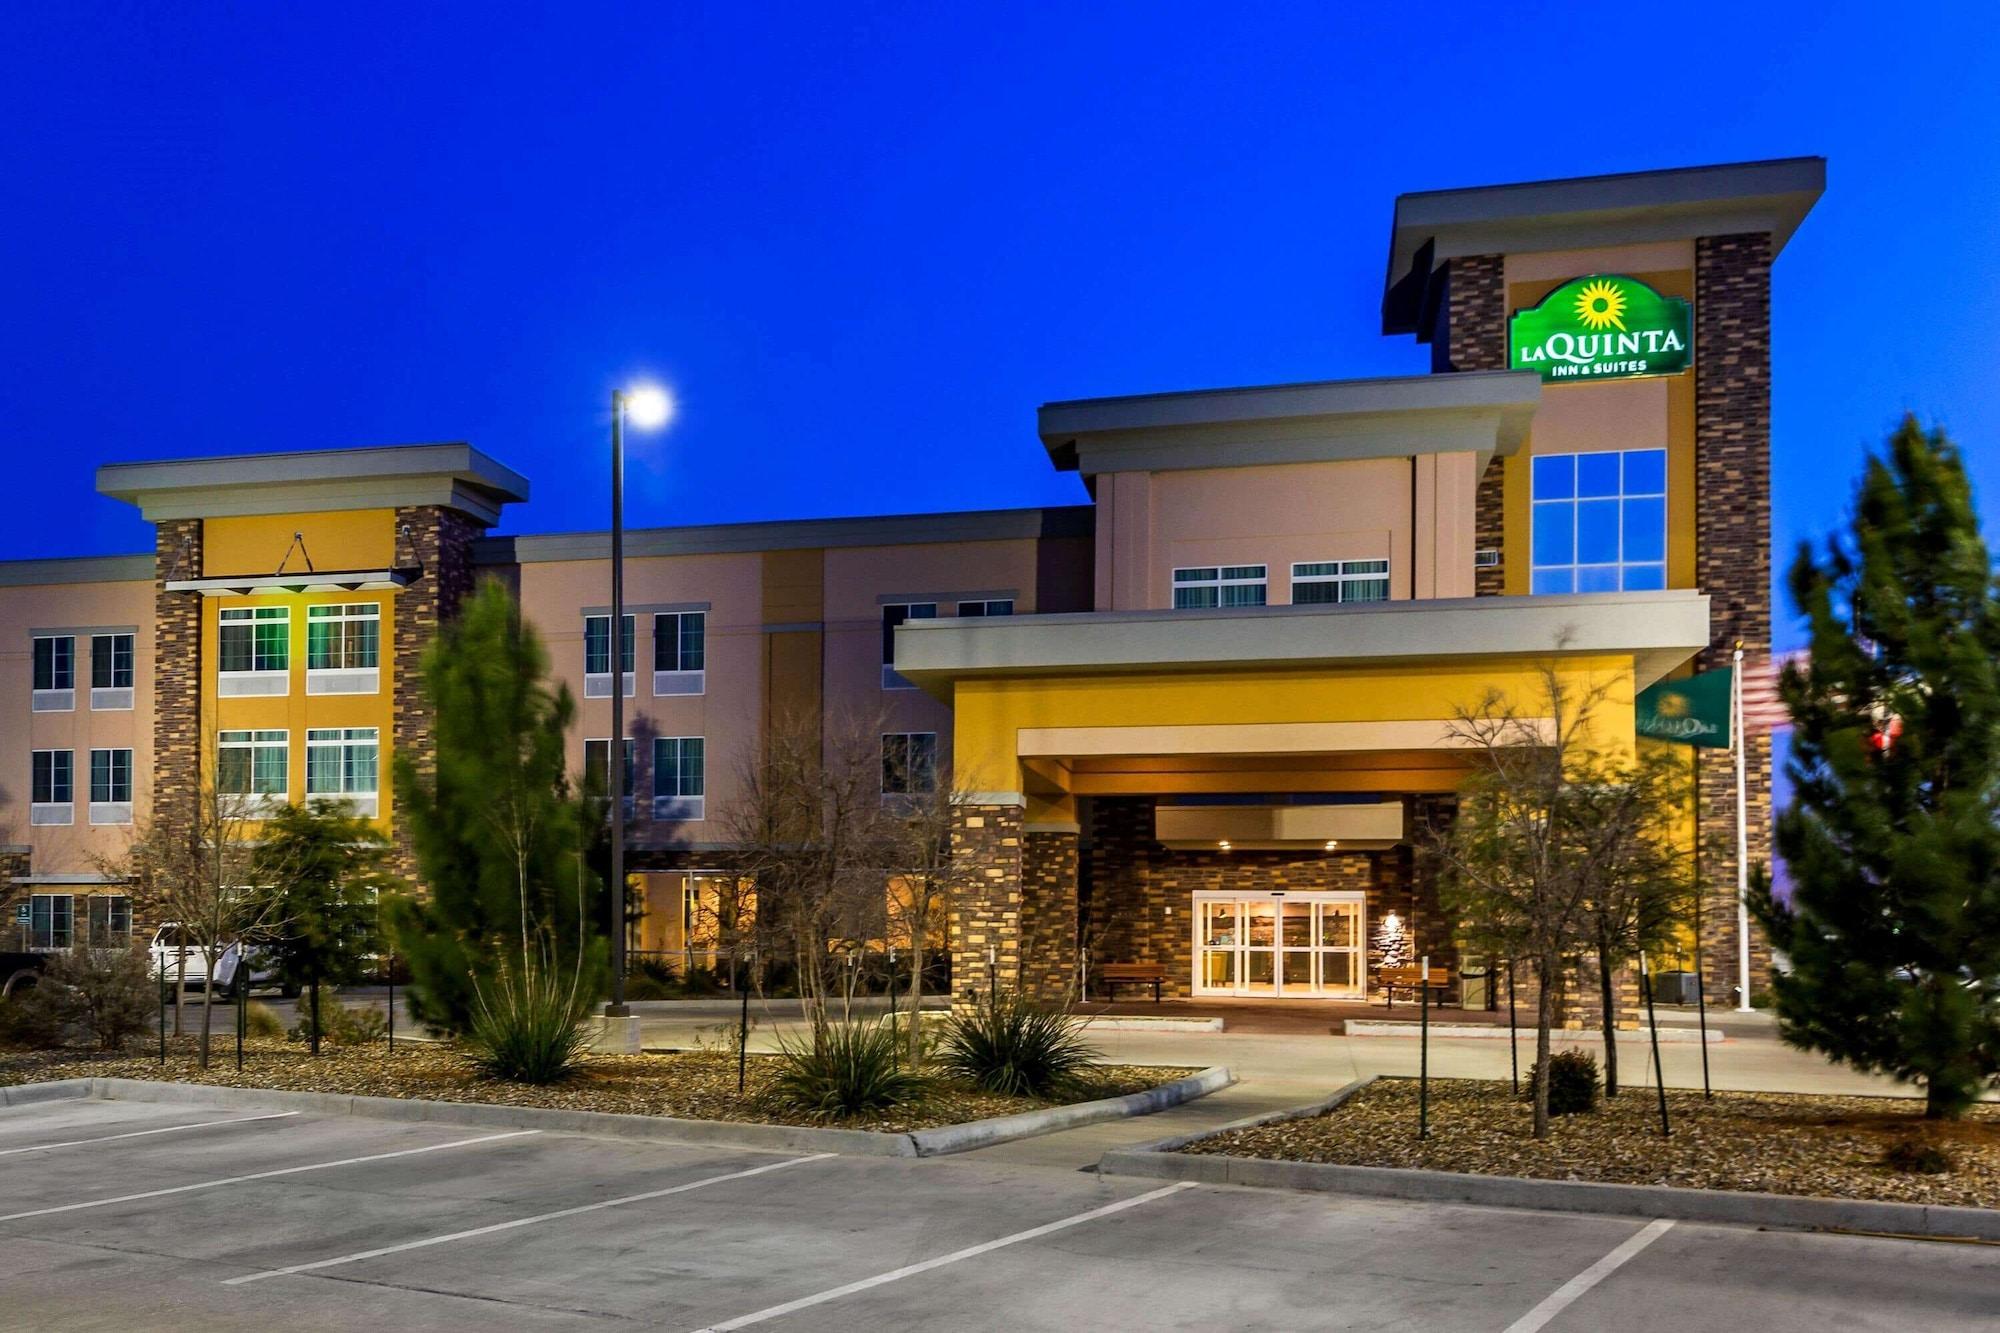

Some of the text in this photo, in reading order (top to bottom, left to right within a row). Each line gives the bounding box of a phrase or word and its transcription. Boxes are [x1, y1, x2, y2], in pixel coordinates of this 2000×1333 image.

[1521, 329, 1685, 364] LA QUINTA
[1552, 360, 1647, 377] INN & SUITES
